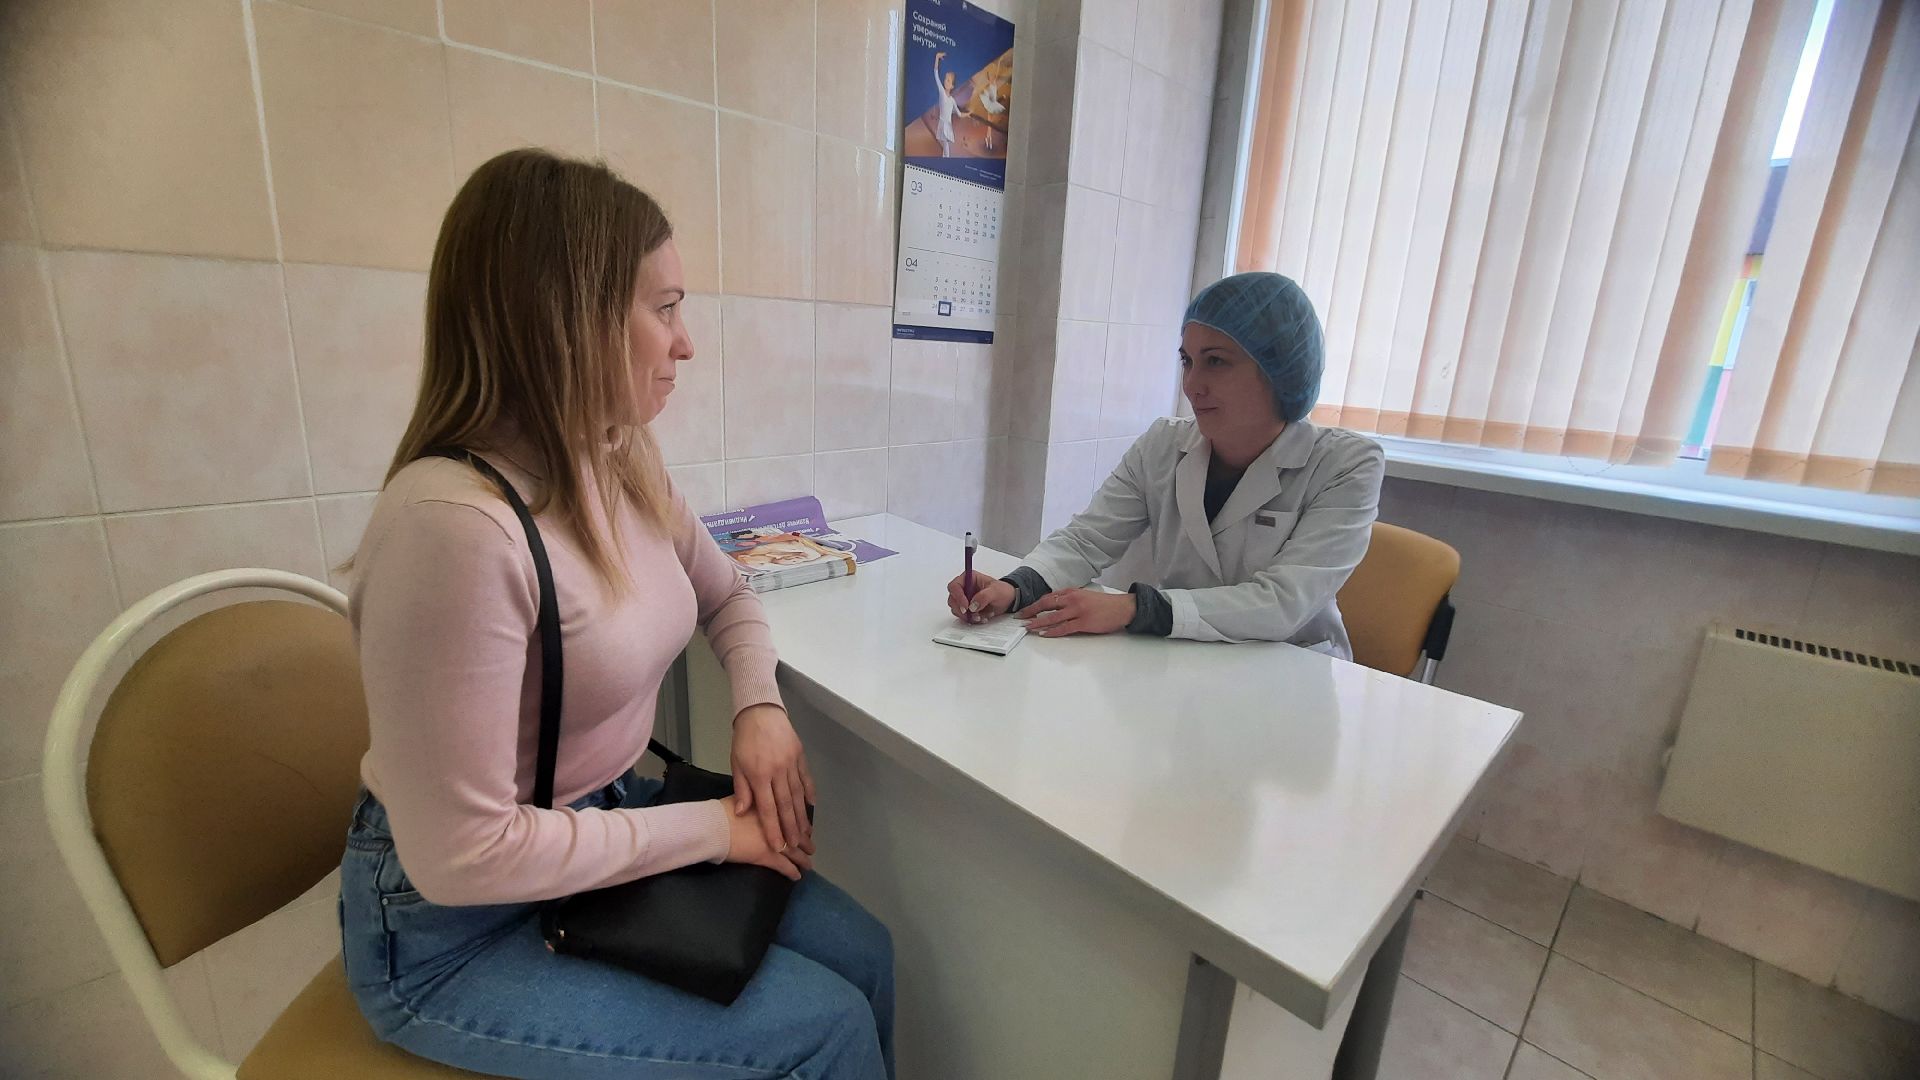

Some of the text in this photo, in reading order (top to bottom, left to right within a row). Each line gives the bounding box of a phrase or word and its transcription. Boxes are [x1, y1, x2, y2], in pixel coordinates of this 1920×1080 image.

[912, 11, 947, 32] Сохраняй
[912, 22, 956, 47] уверенность
[912, 33, 937, 48] внутри
[911, 180, 923, 193] 03
[905, 257, 918, 268] 04
